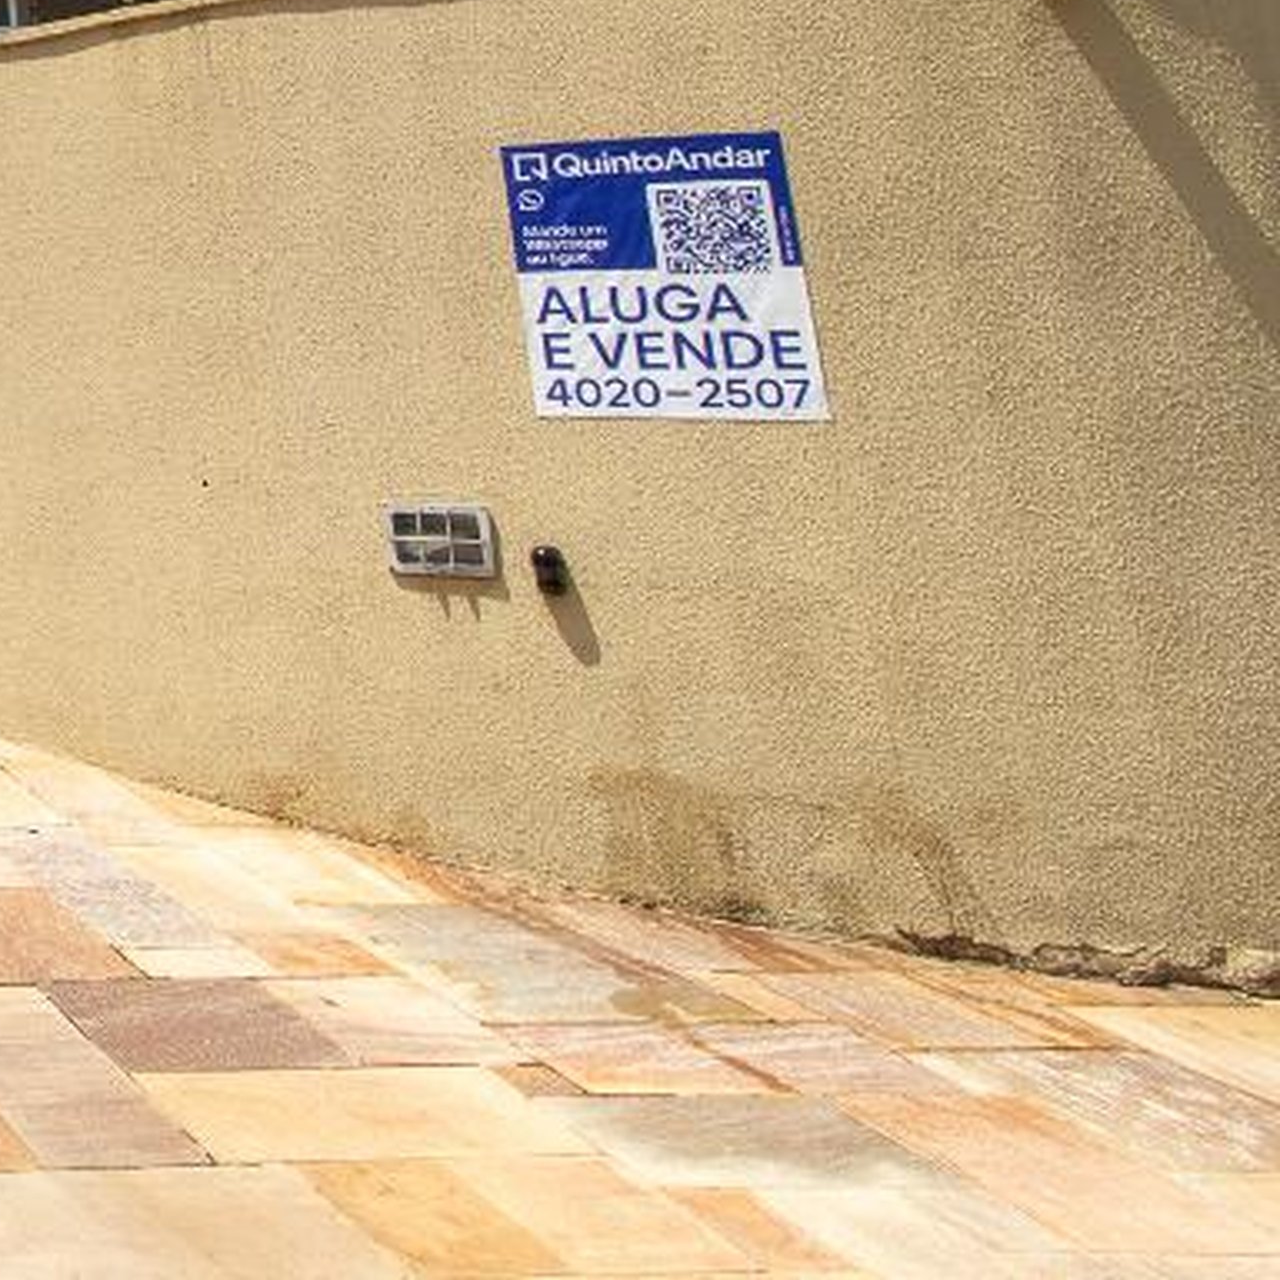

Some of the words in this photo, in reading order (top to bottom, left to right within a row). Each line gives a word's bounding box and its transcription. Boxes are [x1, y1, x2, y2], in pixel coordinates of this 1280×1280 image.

[553, 148, 771, 179] QuintoAndar
[537, 284, 750, 324] ALUGA
[542, 333, 576, 370] E
[590, 330, 808, 370] VENDE
[546, 378, 811, 409] 4020-2507
